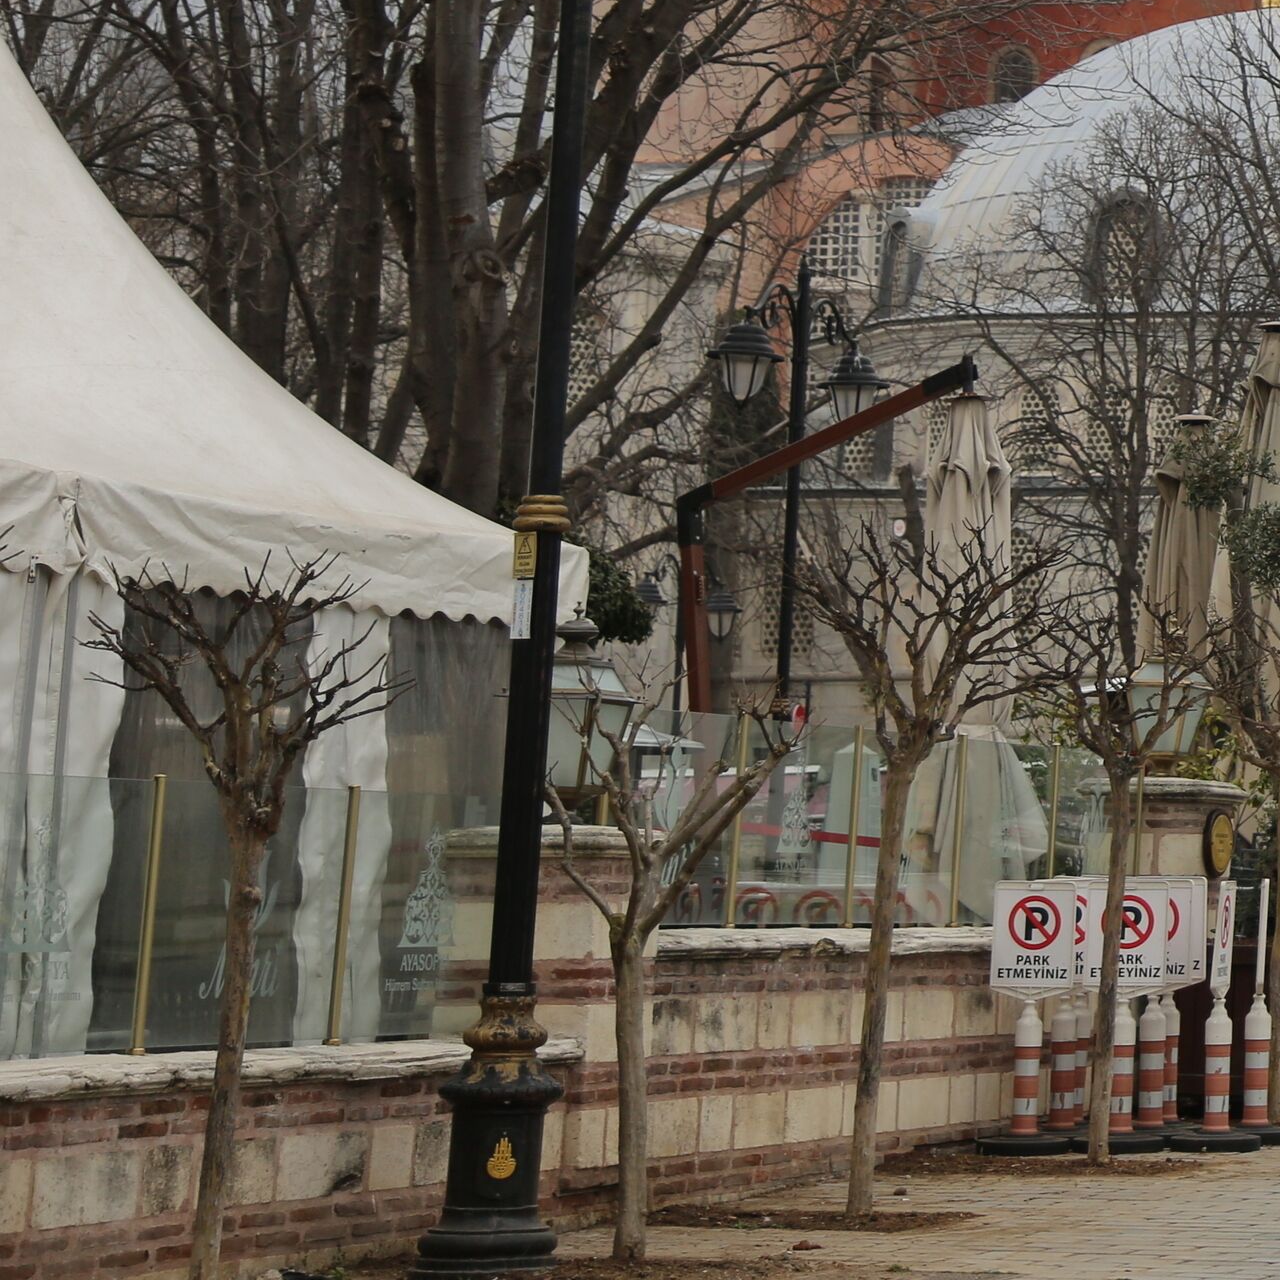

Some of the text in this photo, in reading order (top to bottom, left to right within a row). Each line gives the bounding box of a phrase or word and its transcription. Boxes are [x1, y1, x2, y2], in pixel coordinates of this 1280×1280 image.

[1015, 954, 1051, 966] PARK
[1117, 954, 1143, 965] ARK
[997, 966, 1068, 980] ETMEYİNİZ
[1090, 965, 1161, 978] EEYİNİZ
